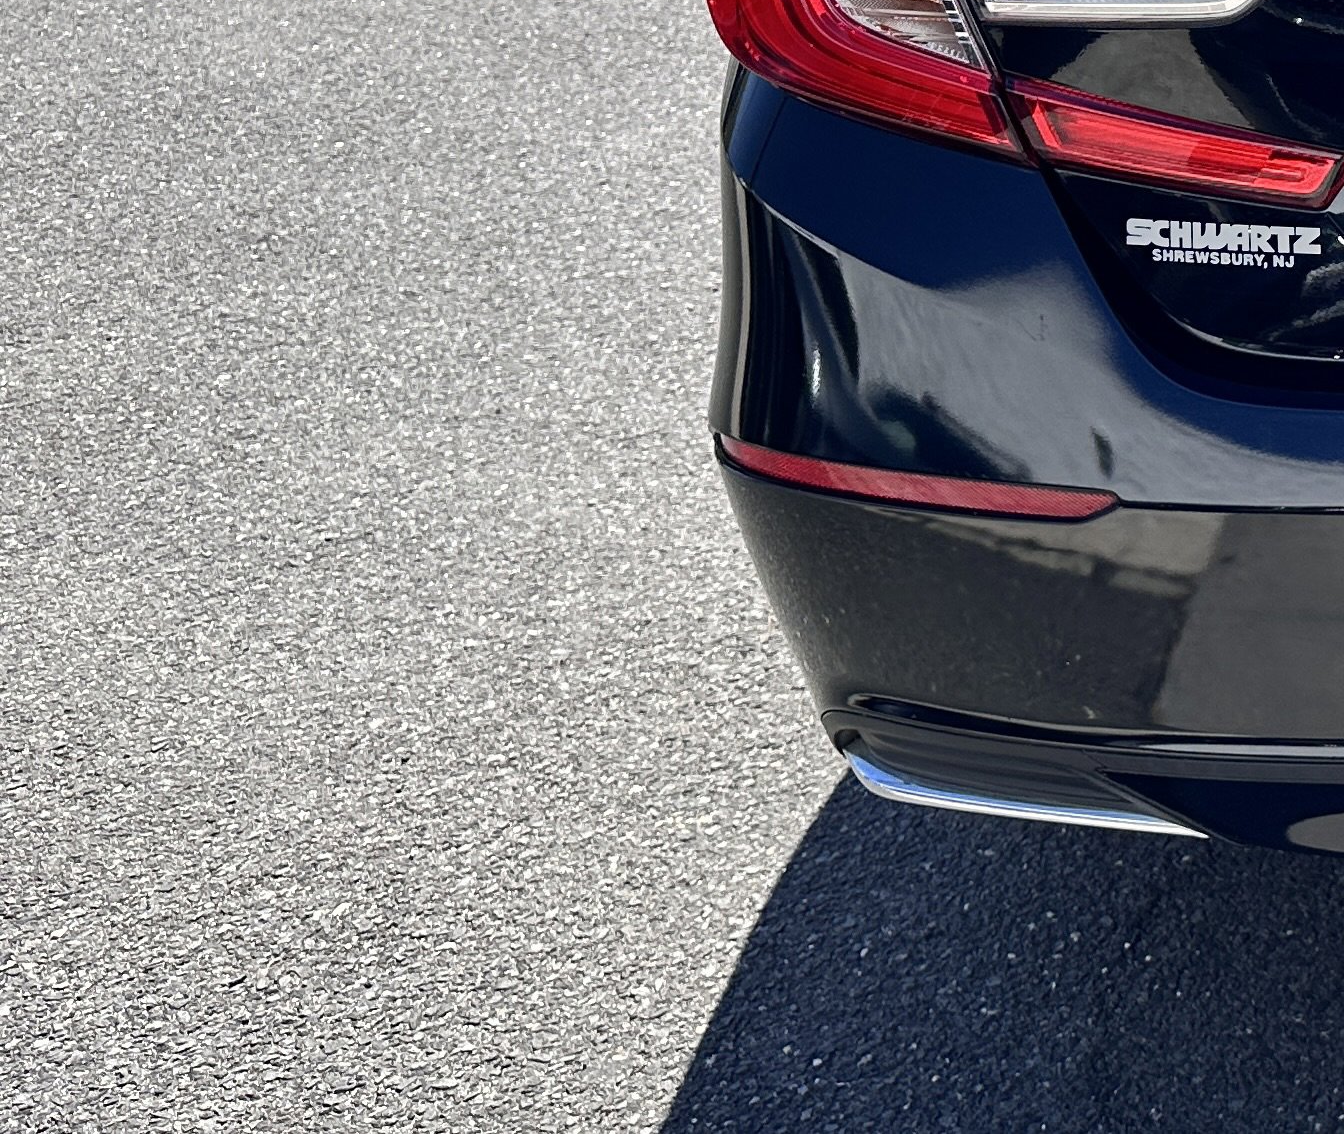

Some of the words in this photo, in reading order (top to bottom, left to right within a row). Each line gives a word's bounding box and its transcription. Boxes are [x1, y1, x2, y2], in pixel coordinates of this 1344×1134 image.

[1126, 218, 1322, 254] SCHWARTZ
[1152, 249, 1268, 269] SHREWSBURY,
[1273, 255, 1295, 268] NJ
